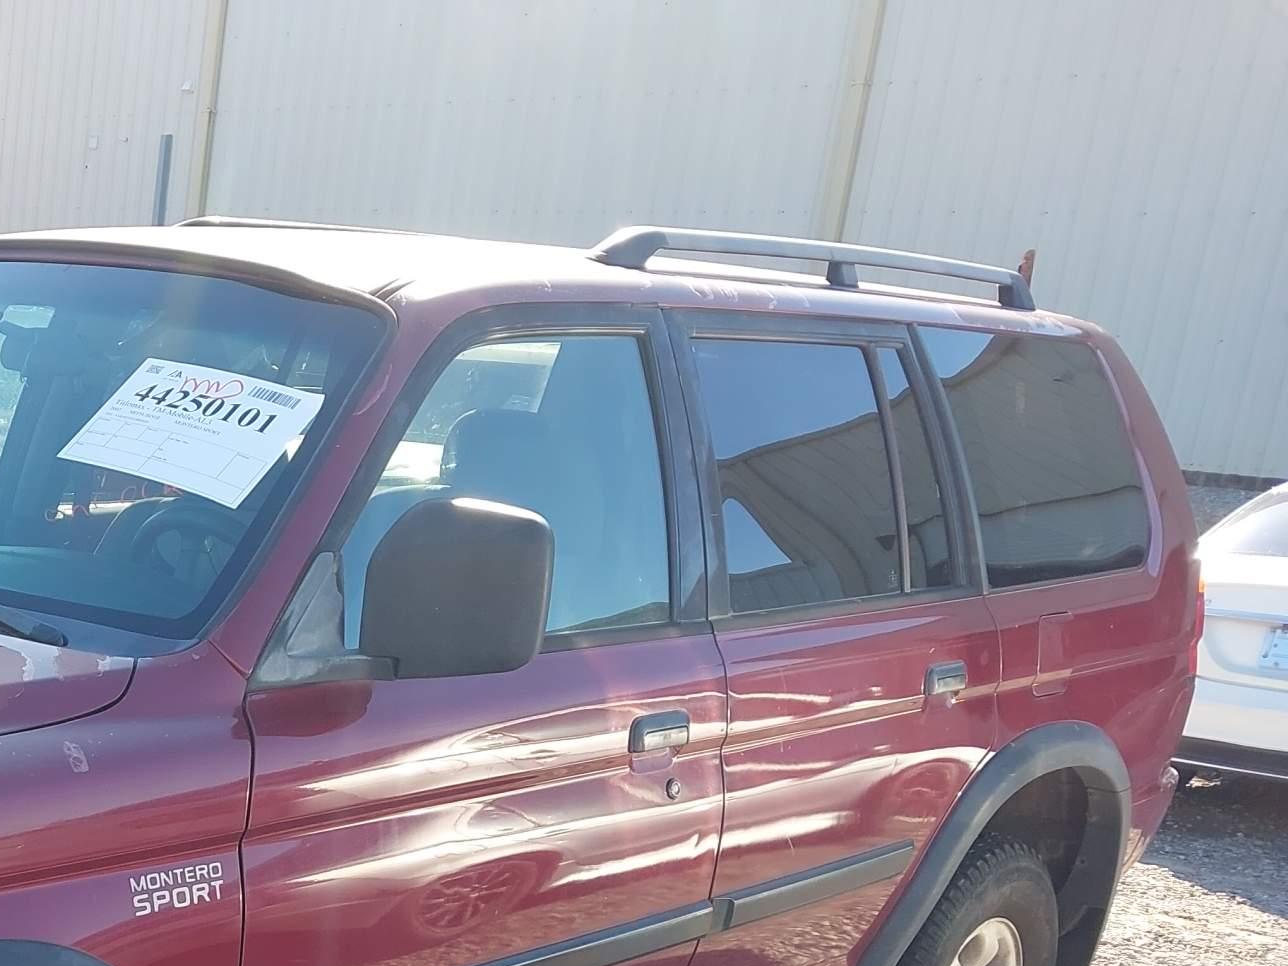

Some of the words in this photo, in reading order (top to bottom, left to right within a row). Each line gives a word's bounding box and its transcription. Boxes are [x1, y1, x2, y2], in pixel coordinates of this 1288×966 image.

[135, 384, 278, 434] 44250101
[129, 862, 223, 893] MONTERO
[133, 880, 224, 917] SPORT
